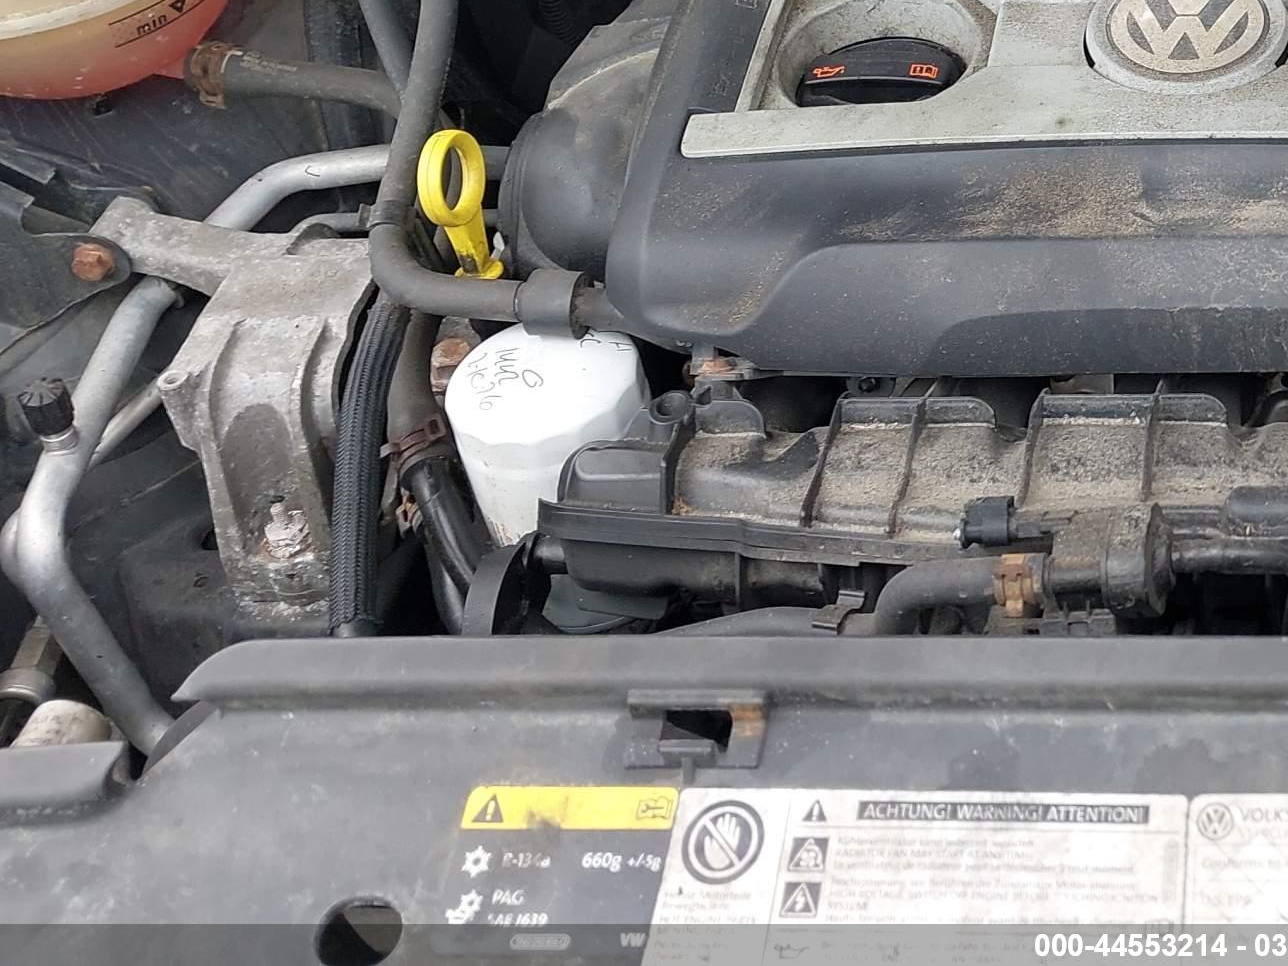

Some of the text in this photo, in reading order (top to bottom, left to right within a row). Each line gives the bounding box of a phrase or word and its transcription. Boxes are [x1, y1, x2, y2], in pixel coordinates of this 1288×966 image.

[136, 14, 168, 35] min
[862, 802, 1144, 824] ACHTUNG! WARNING! ATTENTION!
[581, 851, 622, 872] 660g
[491, 889, 525, 906] PAG
[620, 932, 646, 947] VW
